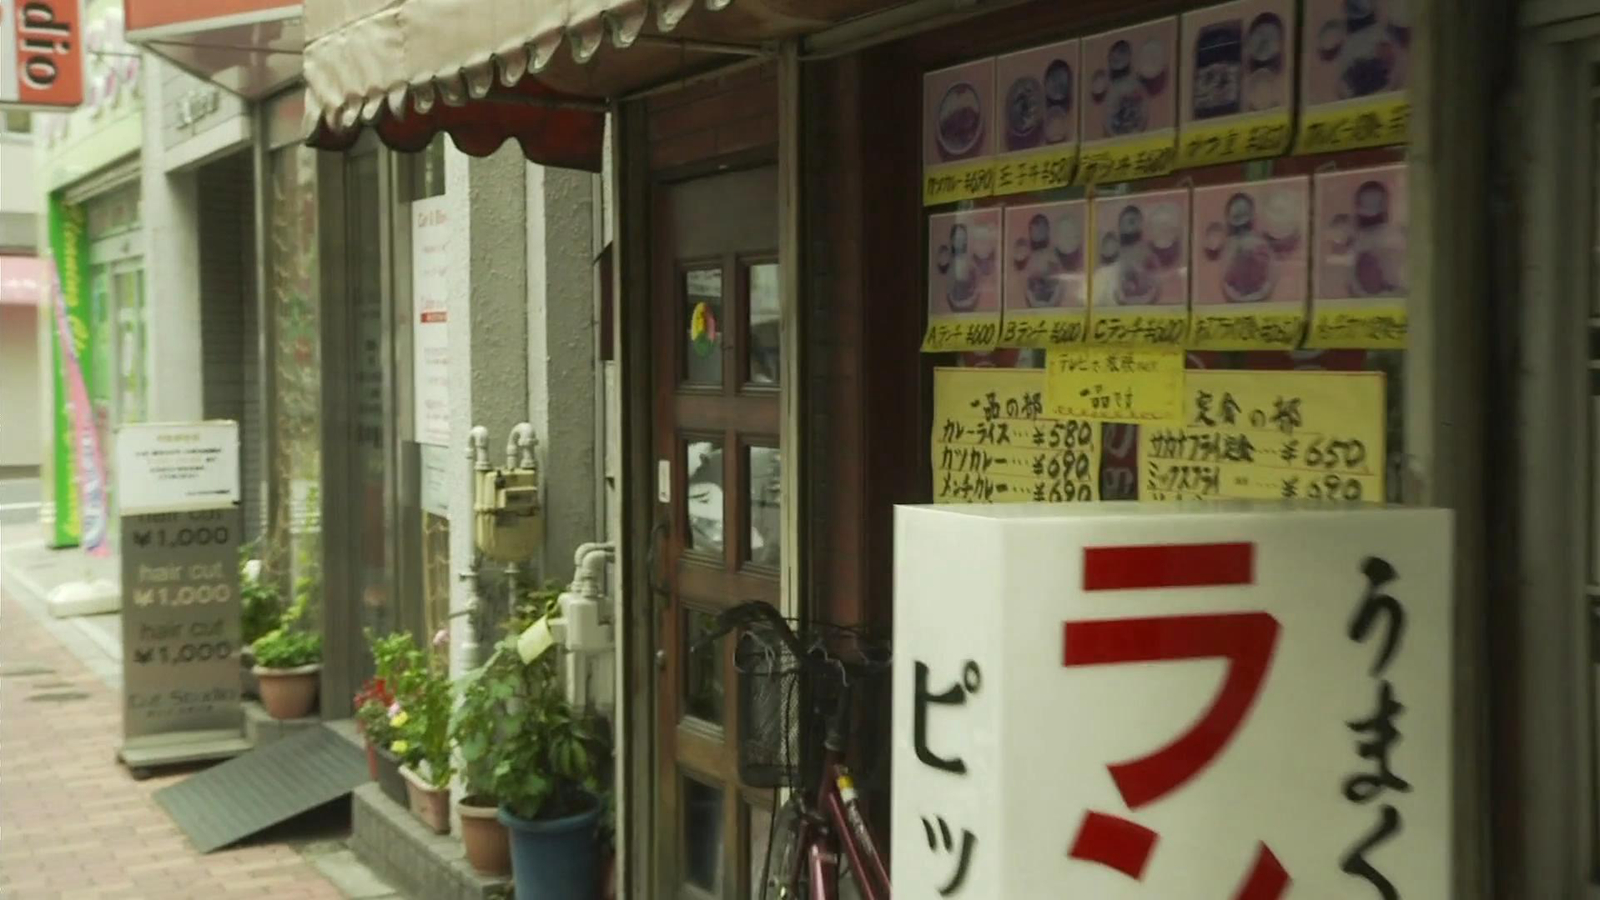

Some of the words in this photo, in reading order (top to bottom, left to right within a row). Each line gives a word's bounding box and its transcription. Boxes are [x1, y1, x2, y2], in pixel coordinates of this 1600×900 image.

[133, 526, 230, 548] ¥1,000
[140, 562, 182, 582] hair
[190, 562, 223, 580] cut
[133, 584, 232, 606] ¥1,000
[140, 621, 182, 641] hair
[191, 618, 224, 637] cut
[133, 642, 232, 665] ¥1,000
